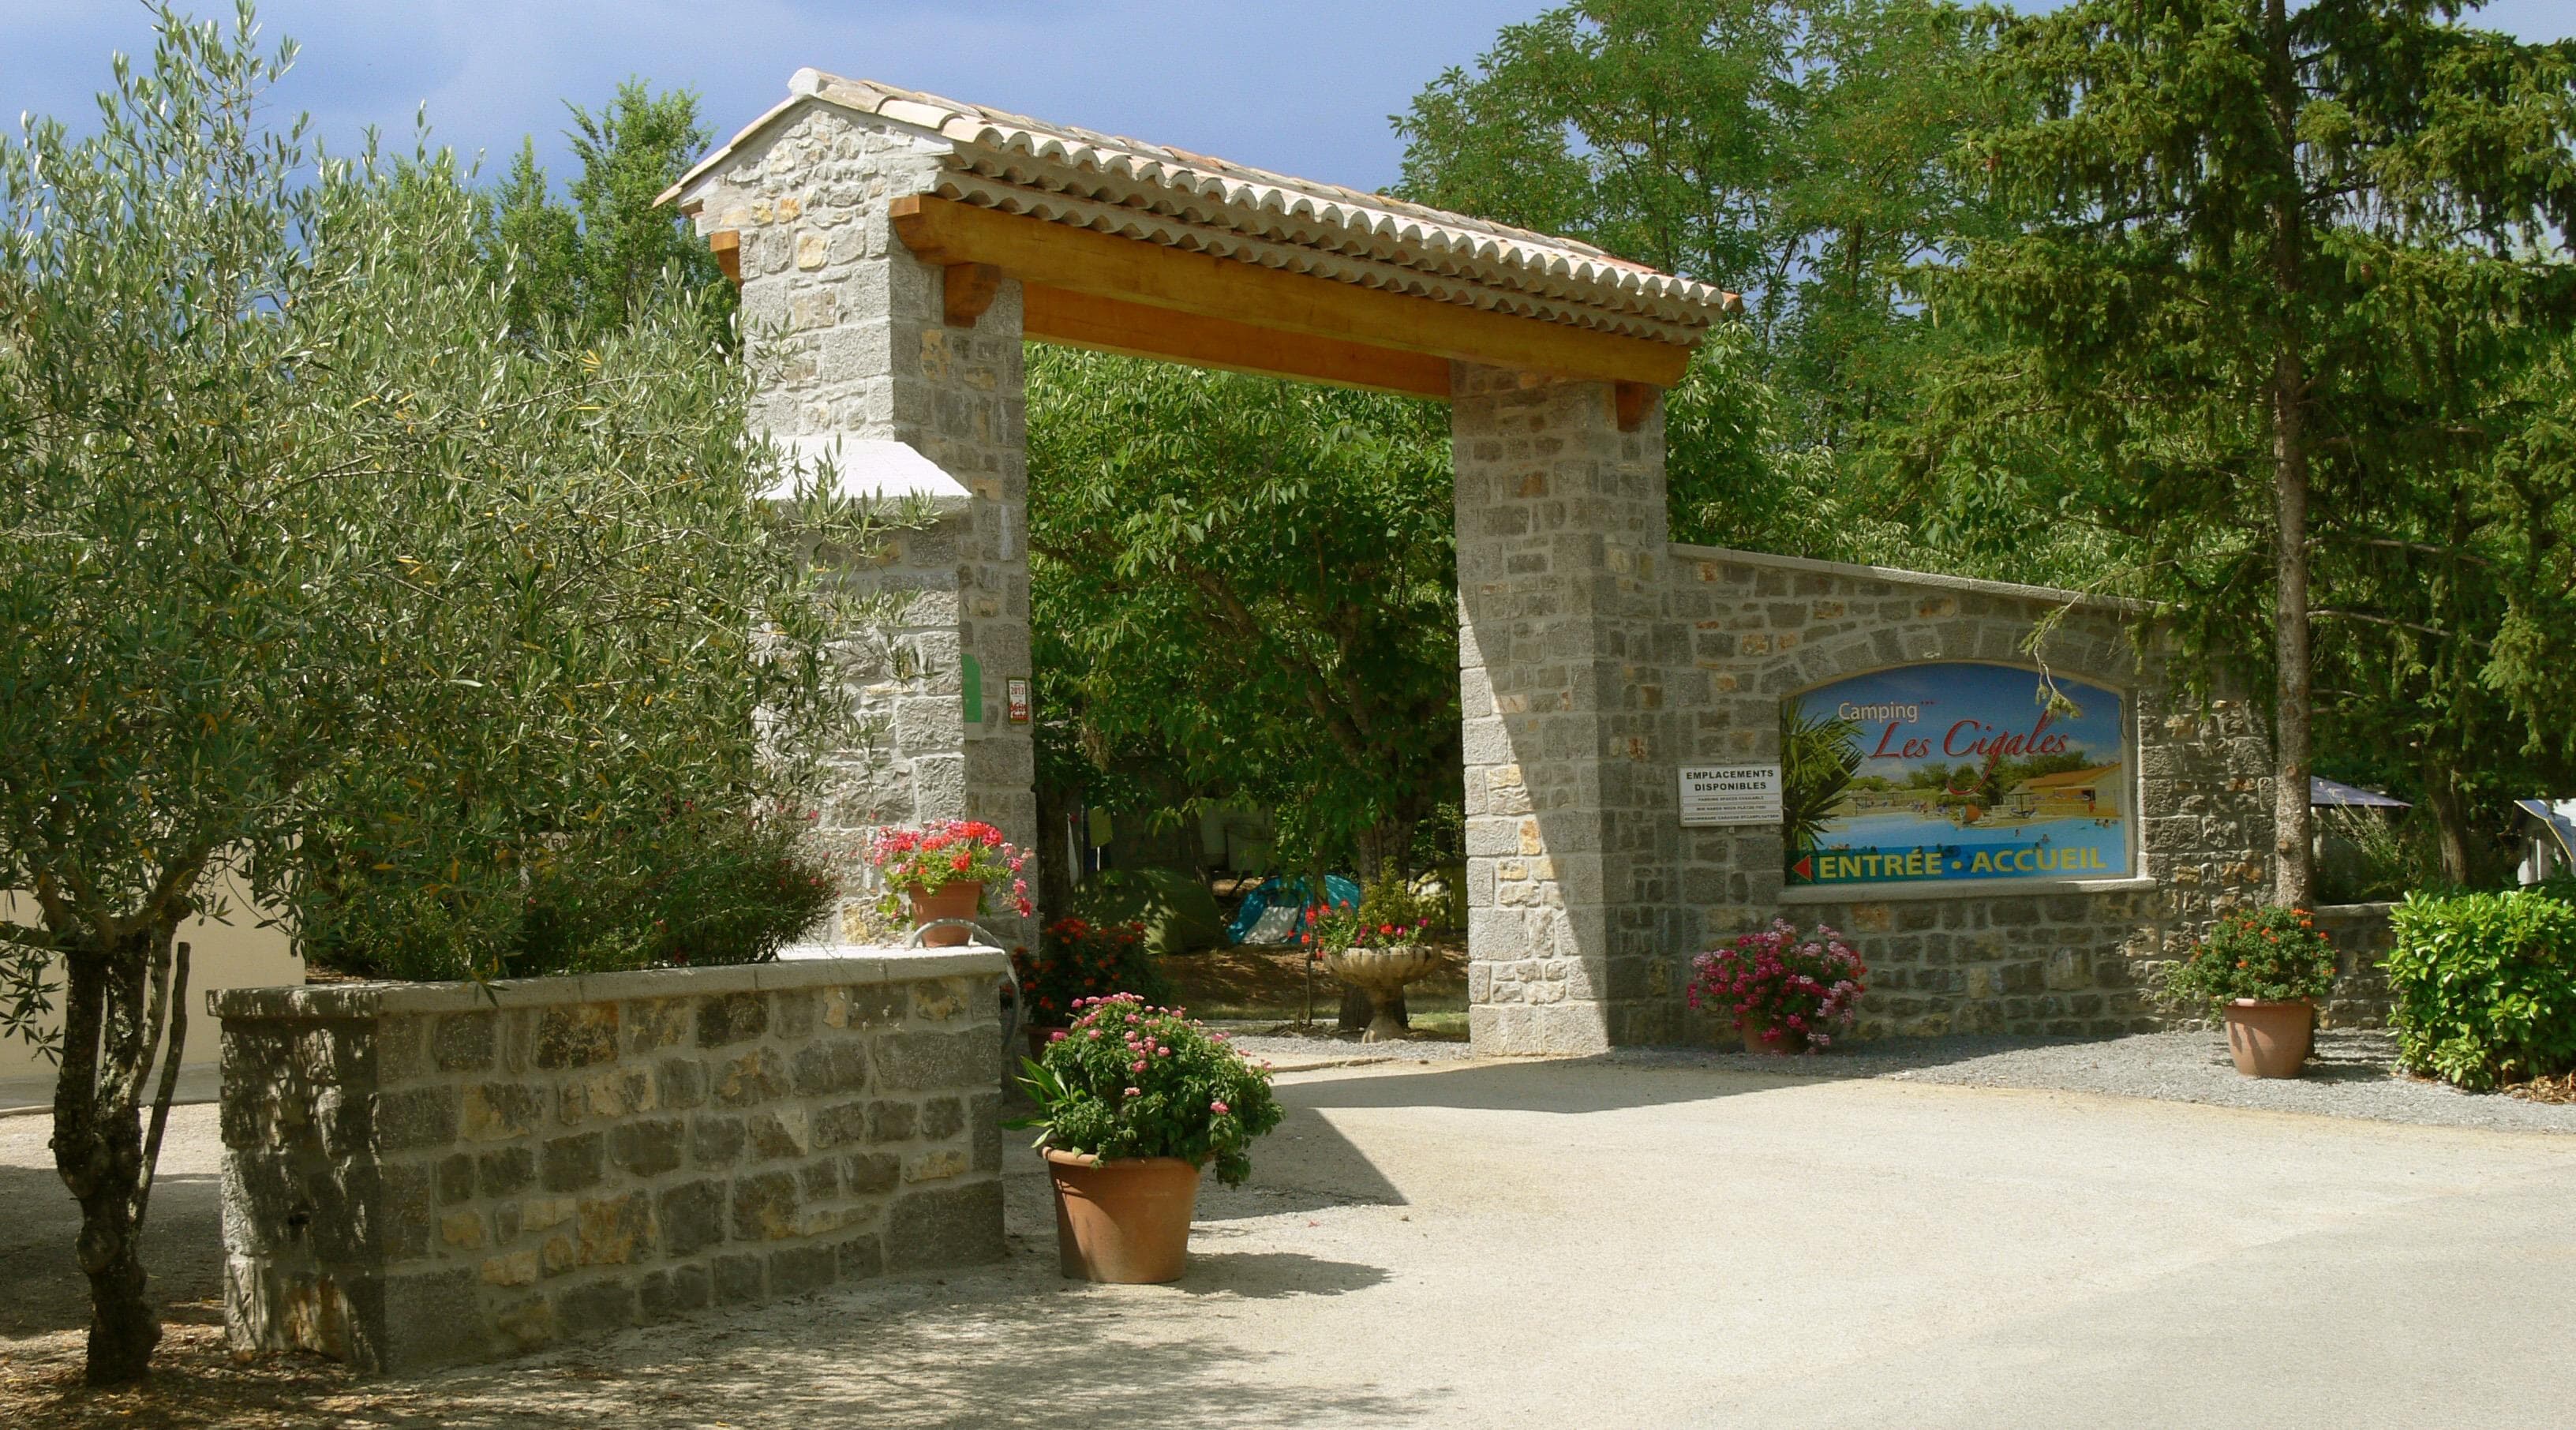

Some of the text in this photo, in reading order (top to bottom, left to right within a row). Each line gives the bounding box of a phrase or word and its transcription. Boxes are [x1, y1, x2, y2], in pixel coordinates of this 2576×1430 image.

[1837, 701, 1919, 724] Camping
[1868, 709, 2069, 795] Les Cigales
[1686, 769, 1774, 780] EMPLACEMENTS
[1694, 781, 1767, 792] DISPONIBLES
[1818, 846, 2108, 879] ENTRÉE ACCUEIL
